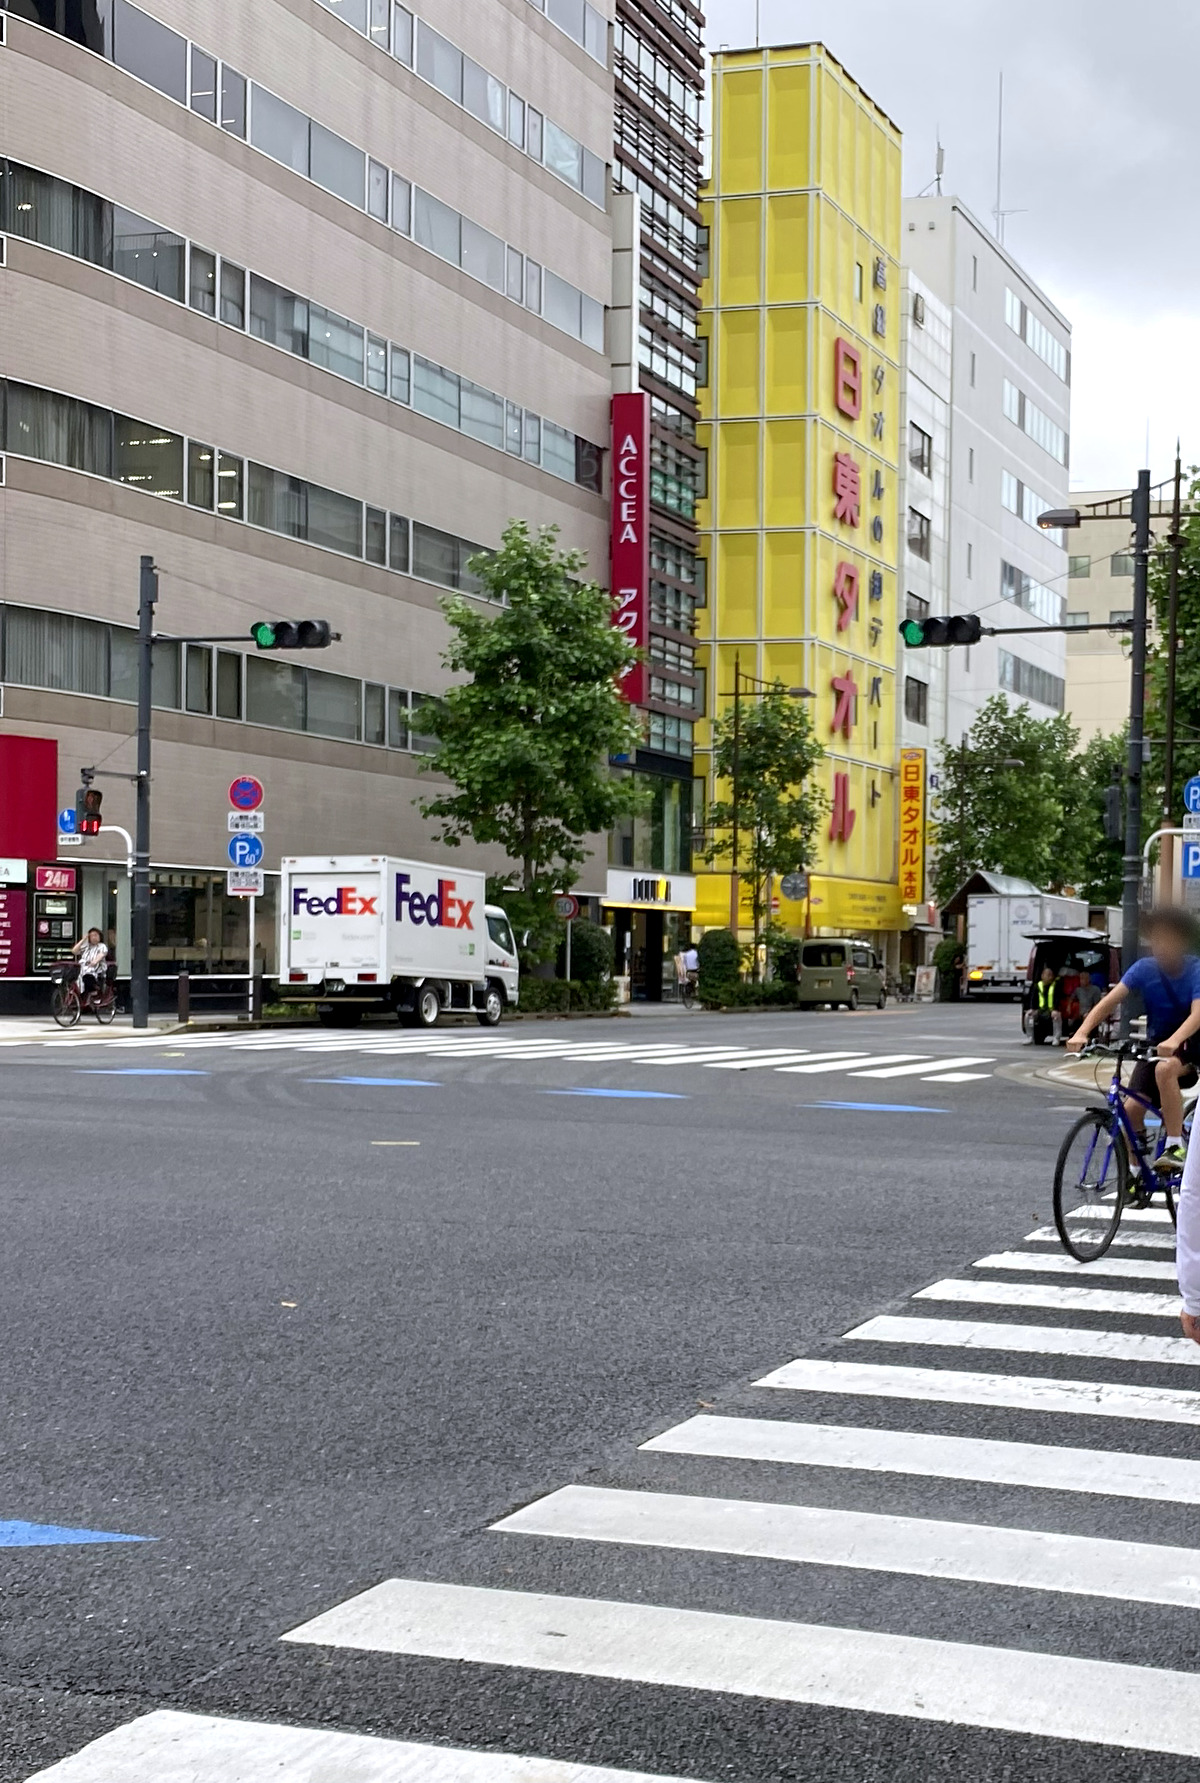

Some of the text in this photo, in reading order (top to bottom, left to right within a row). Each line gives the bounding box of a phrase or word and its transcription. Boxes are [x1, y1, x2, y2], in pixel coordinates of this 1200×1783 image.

[619, 434, 637, 543] ACCEA
[829, 337, 861, 843] 日東タオル
[236, 841, 249, 865] P
[44, 870, 69, 888] 24H
[293, 887, 377, 915] FedEx
[395, 873, 474, 930] FedEx
